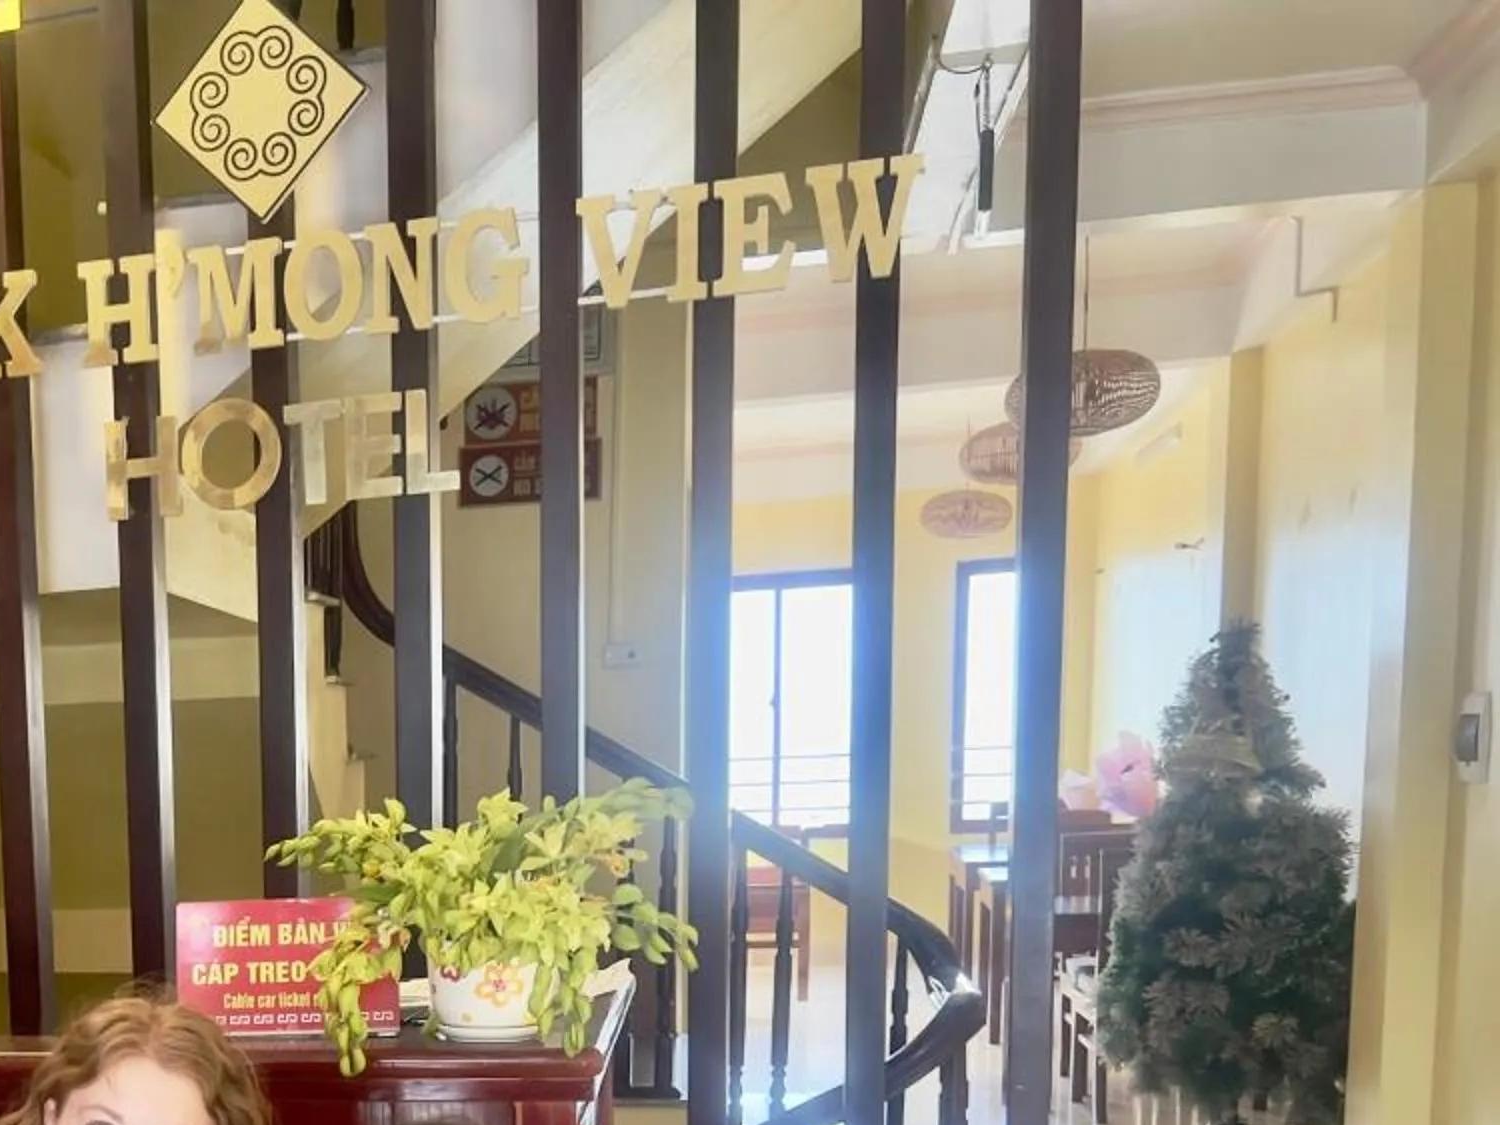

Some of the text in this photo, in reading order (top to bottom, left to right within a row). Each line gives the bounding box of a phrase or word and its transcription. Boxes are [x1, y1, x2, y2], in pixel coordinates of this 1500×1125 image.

[77, 207, 530, 370] H'MONG
[576, 153, 924, 309] VIEW
[104, 388, 461, 521] HOTEL
[213, 915, 270, 948] ĐIỂM
[277, 918, 325, 945] BÁN
[246, 960, 307, 984] TREO
[257, 994, 277, 1008] car
